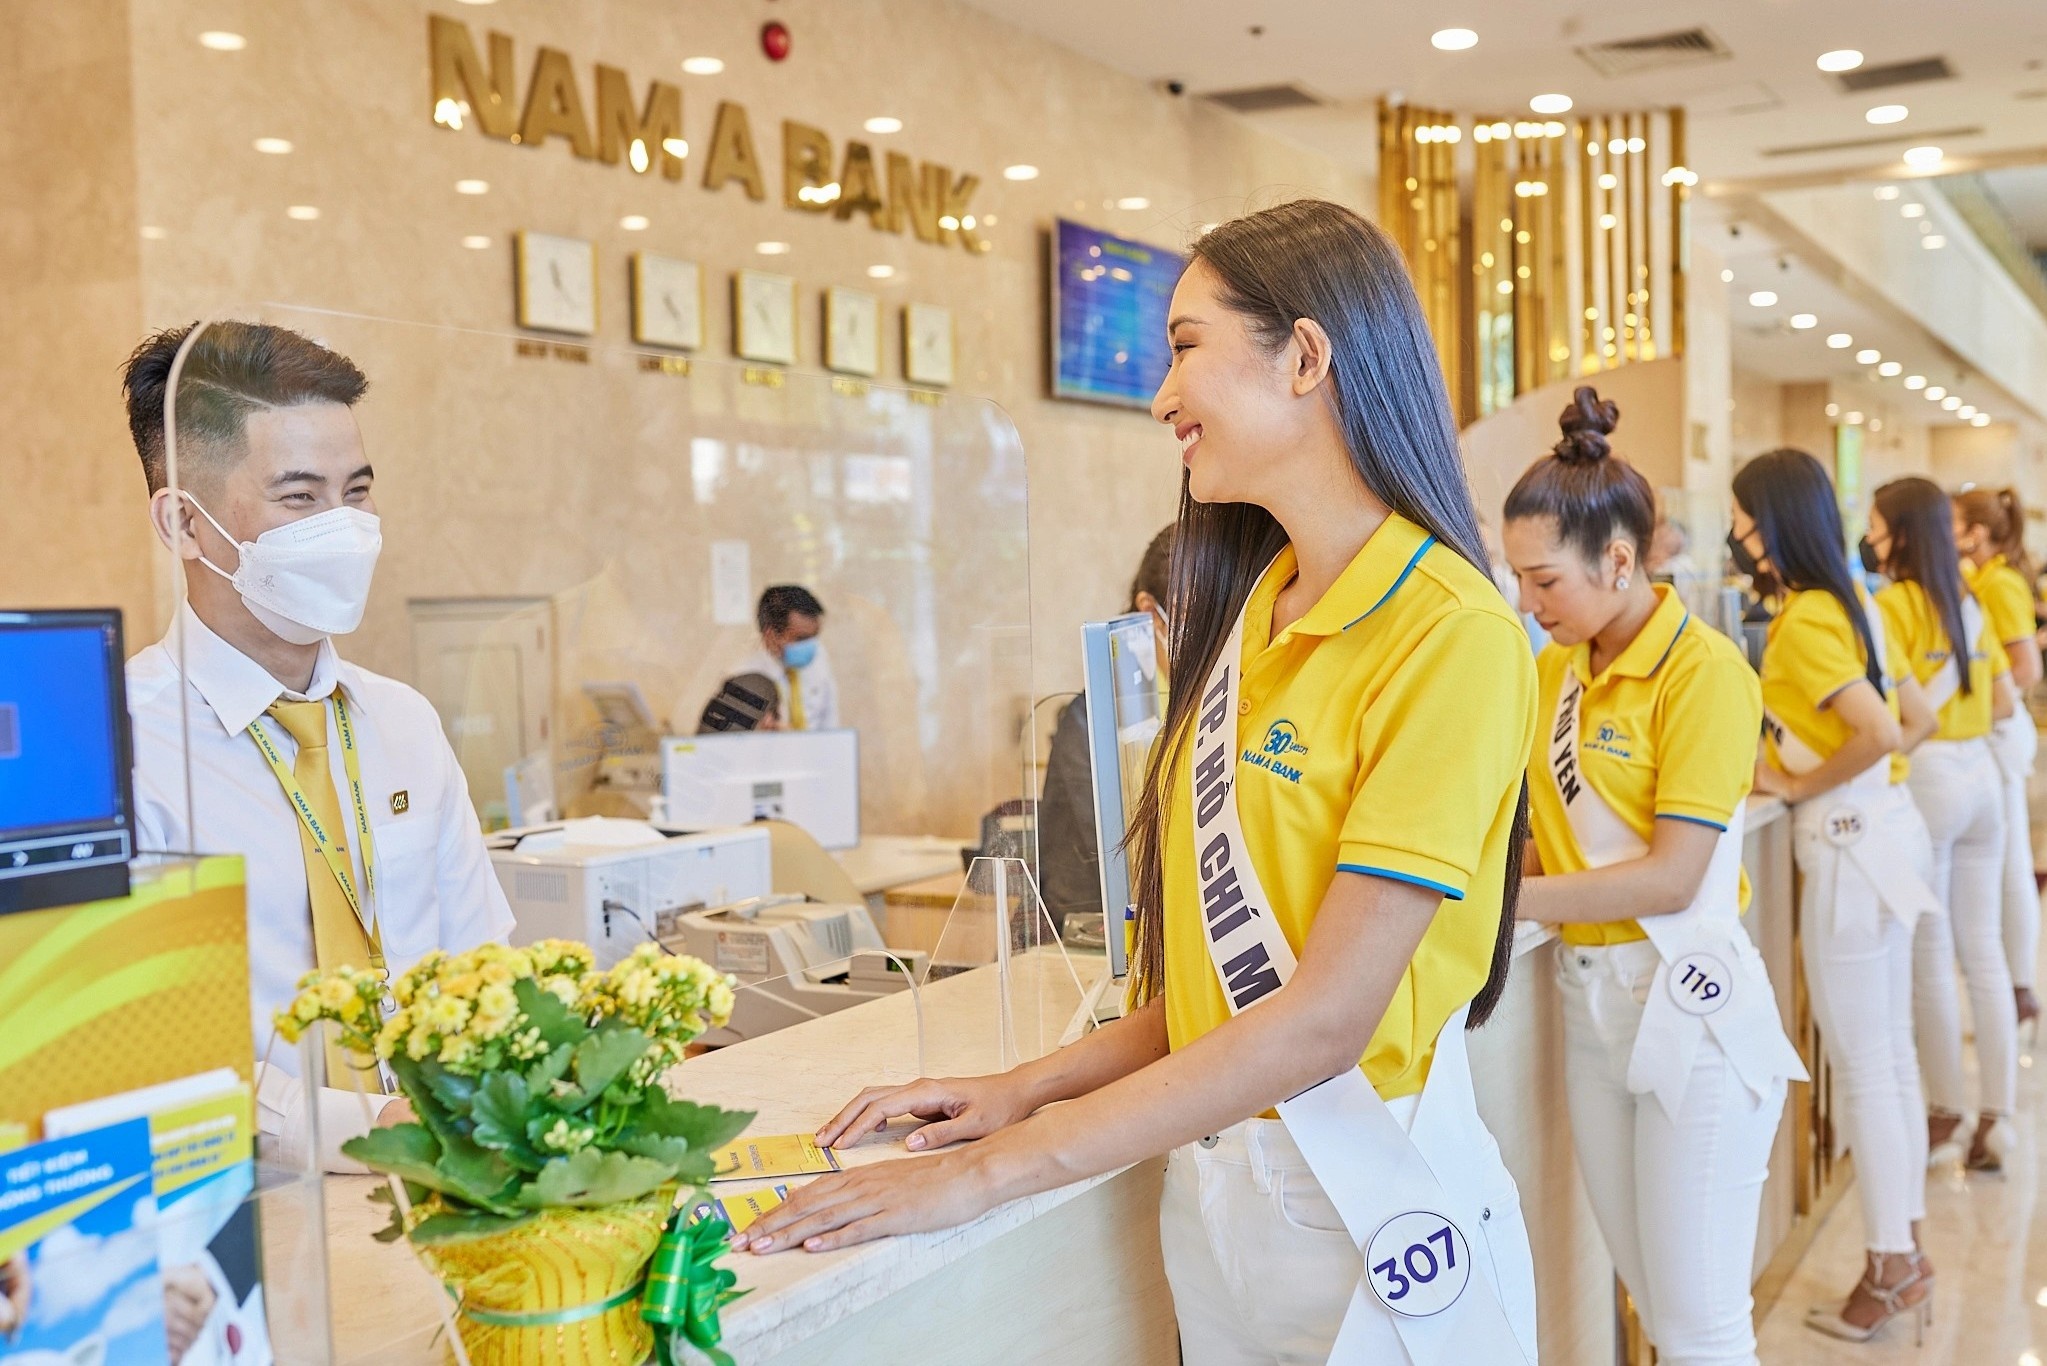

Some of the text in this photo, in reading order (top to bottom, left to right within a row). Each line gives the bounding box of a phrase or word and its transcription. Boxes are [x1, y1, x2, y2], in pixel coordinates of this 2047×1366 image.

[428, 13, 981, 255] NAM A BANK
[336, 698, 347, 722] BANK
[1196, 665, 1231, 749] TP.
[262, 739, 279, 765] BANK
[343, 728, 353, 750] NAM
[1264, 729, 1292, 755] 30
[1241, 749, 1303, 784] NAM A BANK
[353, 780, 363, 805] BANK
[1195, 741, 1234, 829] HỒ
[293, 791, 328, 844] NAM A BANK
[359, 815, 368, 834] NAM
[1200, 832, 1260, 943] CHÍ
[1679, 964, 1721, 1001] 119
[1373, 1226, 1457, 1301] 307
